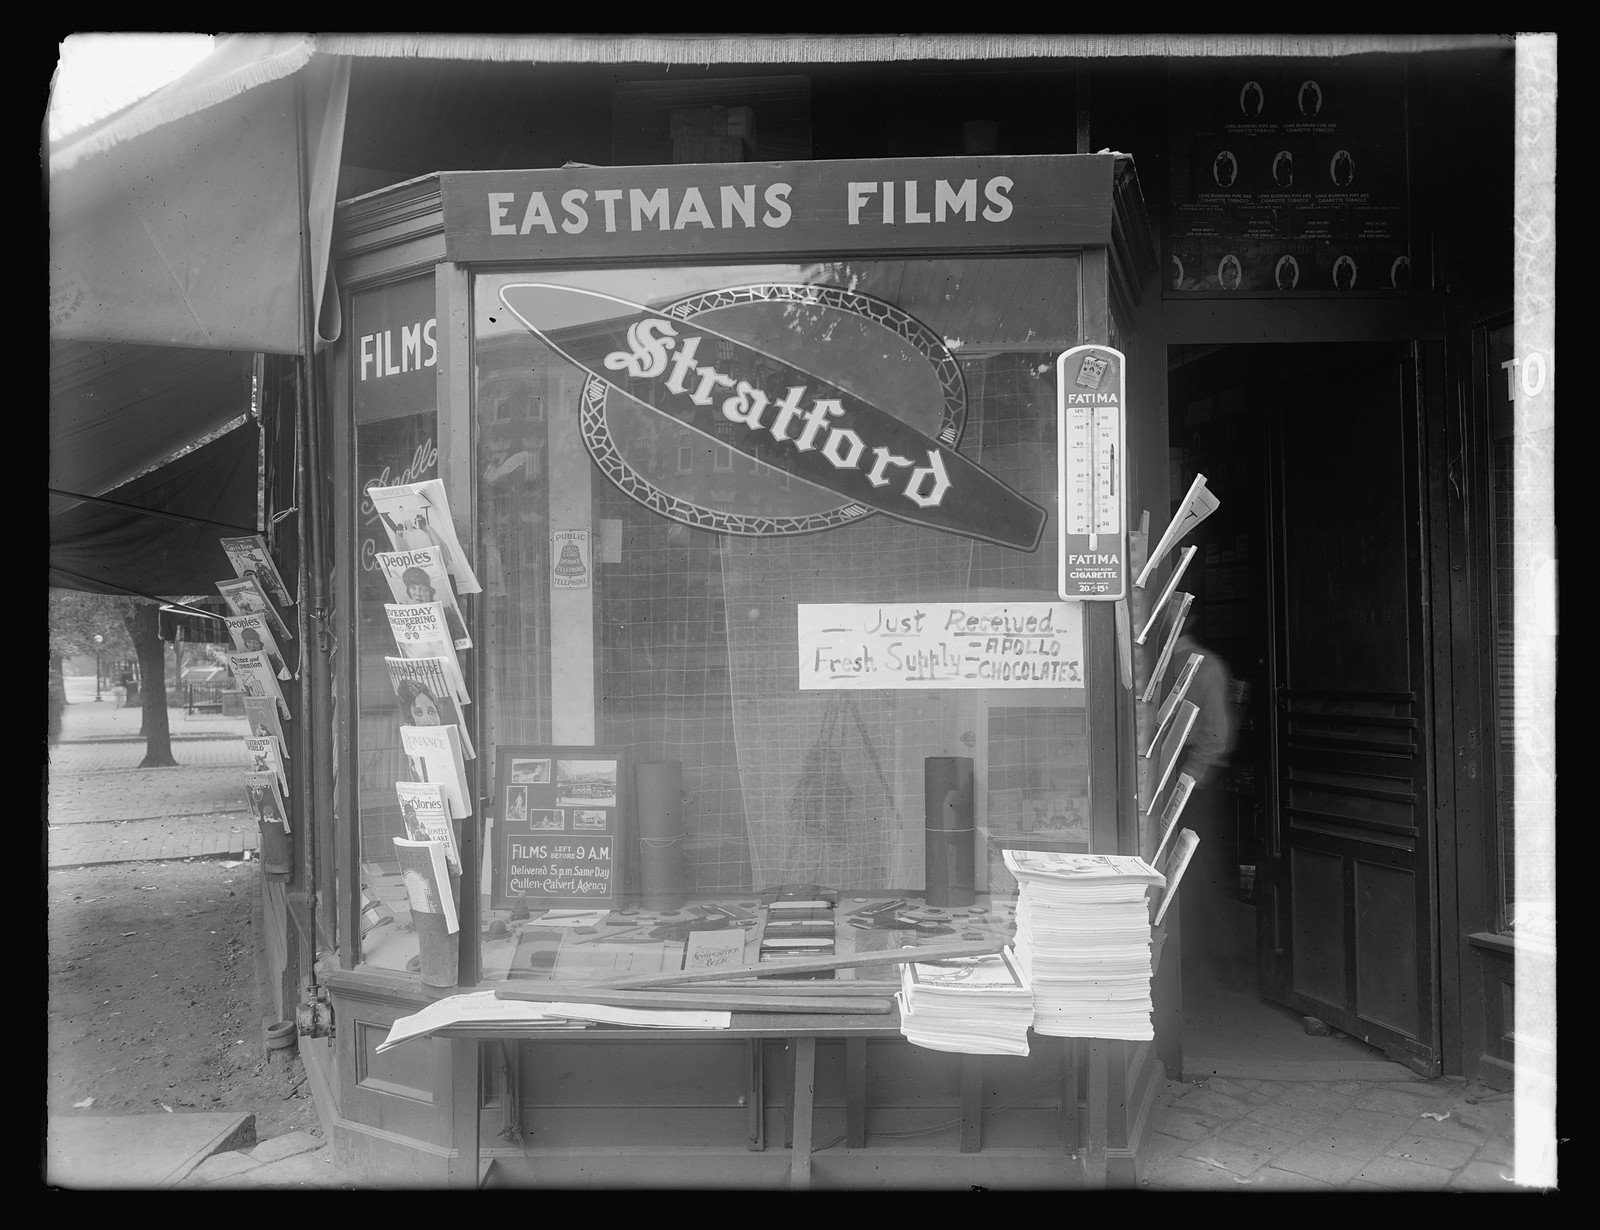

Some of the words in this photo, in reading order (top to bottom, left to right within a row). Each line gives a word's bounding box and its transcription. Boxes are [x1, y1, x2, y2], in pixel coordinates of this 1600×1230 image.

[488, 182, 793, 236] EASTMANS
[848, 176, 1015, 225] FILMS
[360, 318, 438, 381] FILMS
[1068, 393, 1119, 404] FATIMA
[603, 317, 955, 509] Stratford
[555, 533, 586, 541] PUBLIC
[1068, 554, 1119, 565] FATIMA
[554, 577, 587, 586] TELEPHONE
[1069, 571, 1118, 579] CIGARETTE
[864, 608, 926, 635] Just
[945, 607, 1054, 634] Received
[985, 637, 1061, 657] APOLLO
[815, 644, 878, 673] Fresh
[885, 642, 961, 680] Supply
[412, 796, 443, 810] Stories
[512, 844, 548, 860] FILMS
[576, 846, 586, 860] 9
[588, 846, 611, 861] A.M.
[511, 865, 548, 876] Delivered
[550, 864, 558, 876] 5
[574, 866, 594, 877] Same
[595, 866, 610, 880] Day
[510, 877, 575, 893] Cullen-Calvert
[572, 879, 607, 894] Agency
